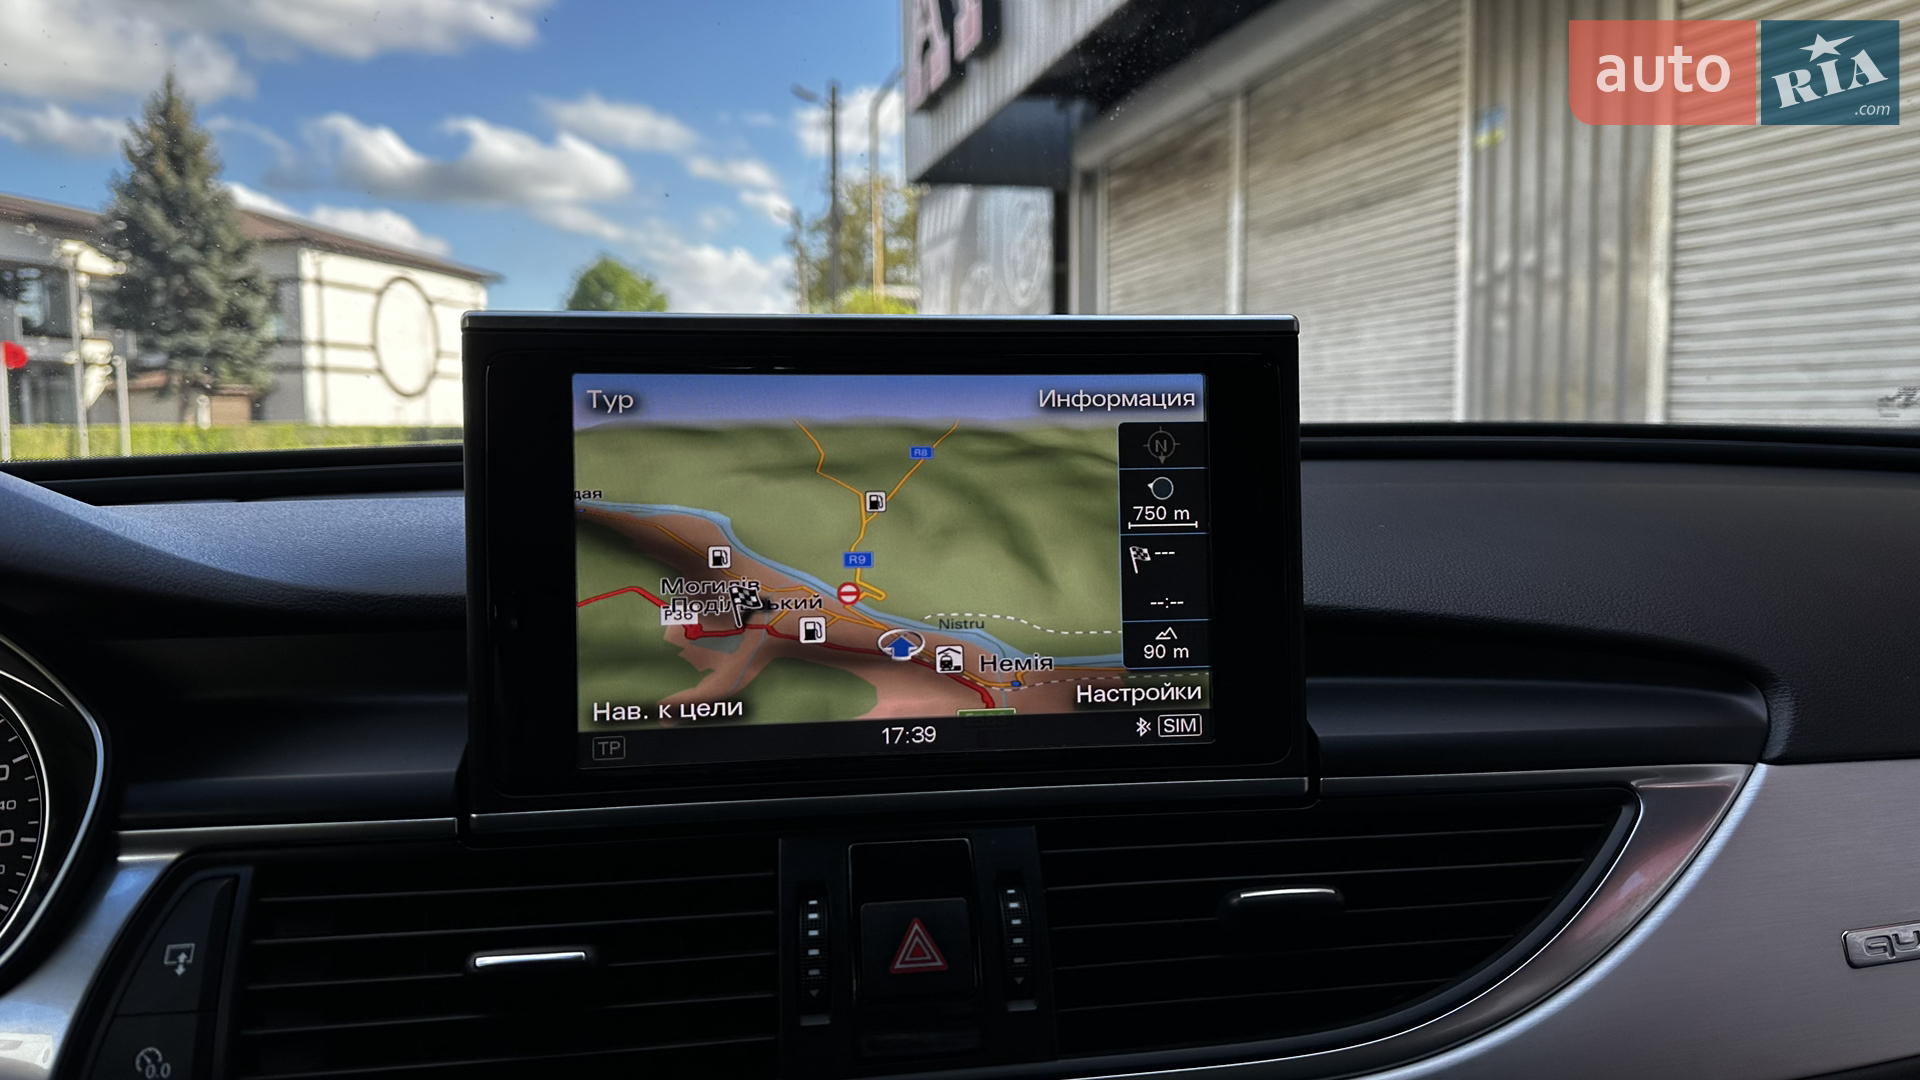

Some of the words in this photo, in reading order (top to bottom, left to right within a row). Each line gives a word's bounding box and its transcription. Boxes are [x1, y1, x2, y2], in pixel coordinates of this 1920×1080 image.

[586, 389, 635, 413] Тур
[1038, 388, 1196, 411] Информация
[1132, 506, 1167, 521] 750
[1173, 508, 1190, 520] m
[849, 554, 867, 565] R9
[938, 618, 985, 631] Nistru
[1143, 645, 1167, 659] 90
[1173, 647, 1189, 659] m
[979, 653, 1054, 672] Немія
[1076, 682, 1202, 706] Настройки
[593, 702, 648, 722] Нав.
[658, 704, 672, 719] к
[680, 701, 744, 720] цели
[1163, 717, 1197, 733] SIM
[881, 725, 937, 744] 17:39
[597, 741, 621, 756] TP
